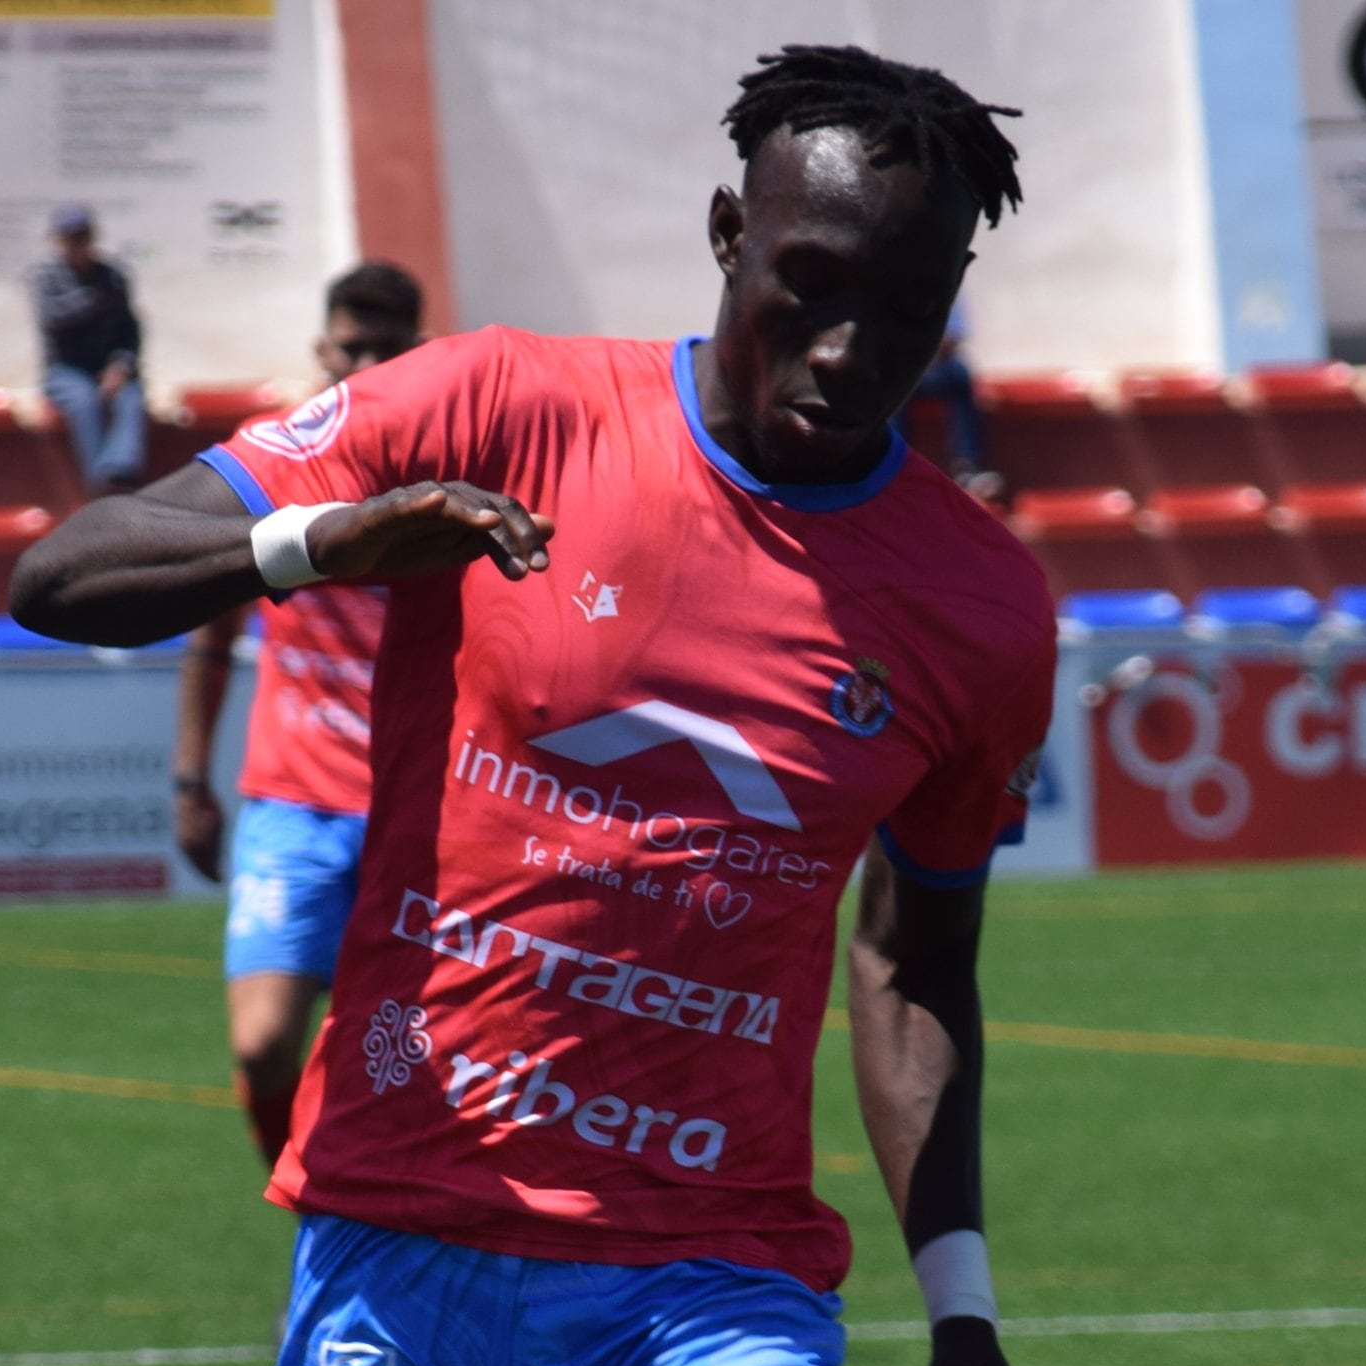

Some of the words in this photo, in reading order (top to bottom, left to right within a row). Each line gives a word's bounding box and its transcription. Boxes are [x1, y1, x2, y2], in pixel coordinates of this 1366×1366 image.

[454, 728, 832, 890] inmohogares
[521, 835, 547, 867] Se
[557, 845, 621, 890] trata
[633, 869, 663, 901] de
[673, 877, 695, 909] ti
[444, 1049, 727, 1172] ribera
